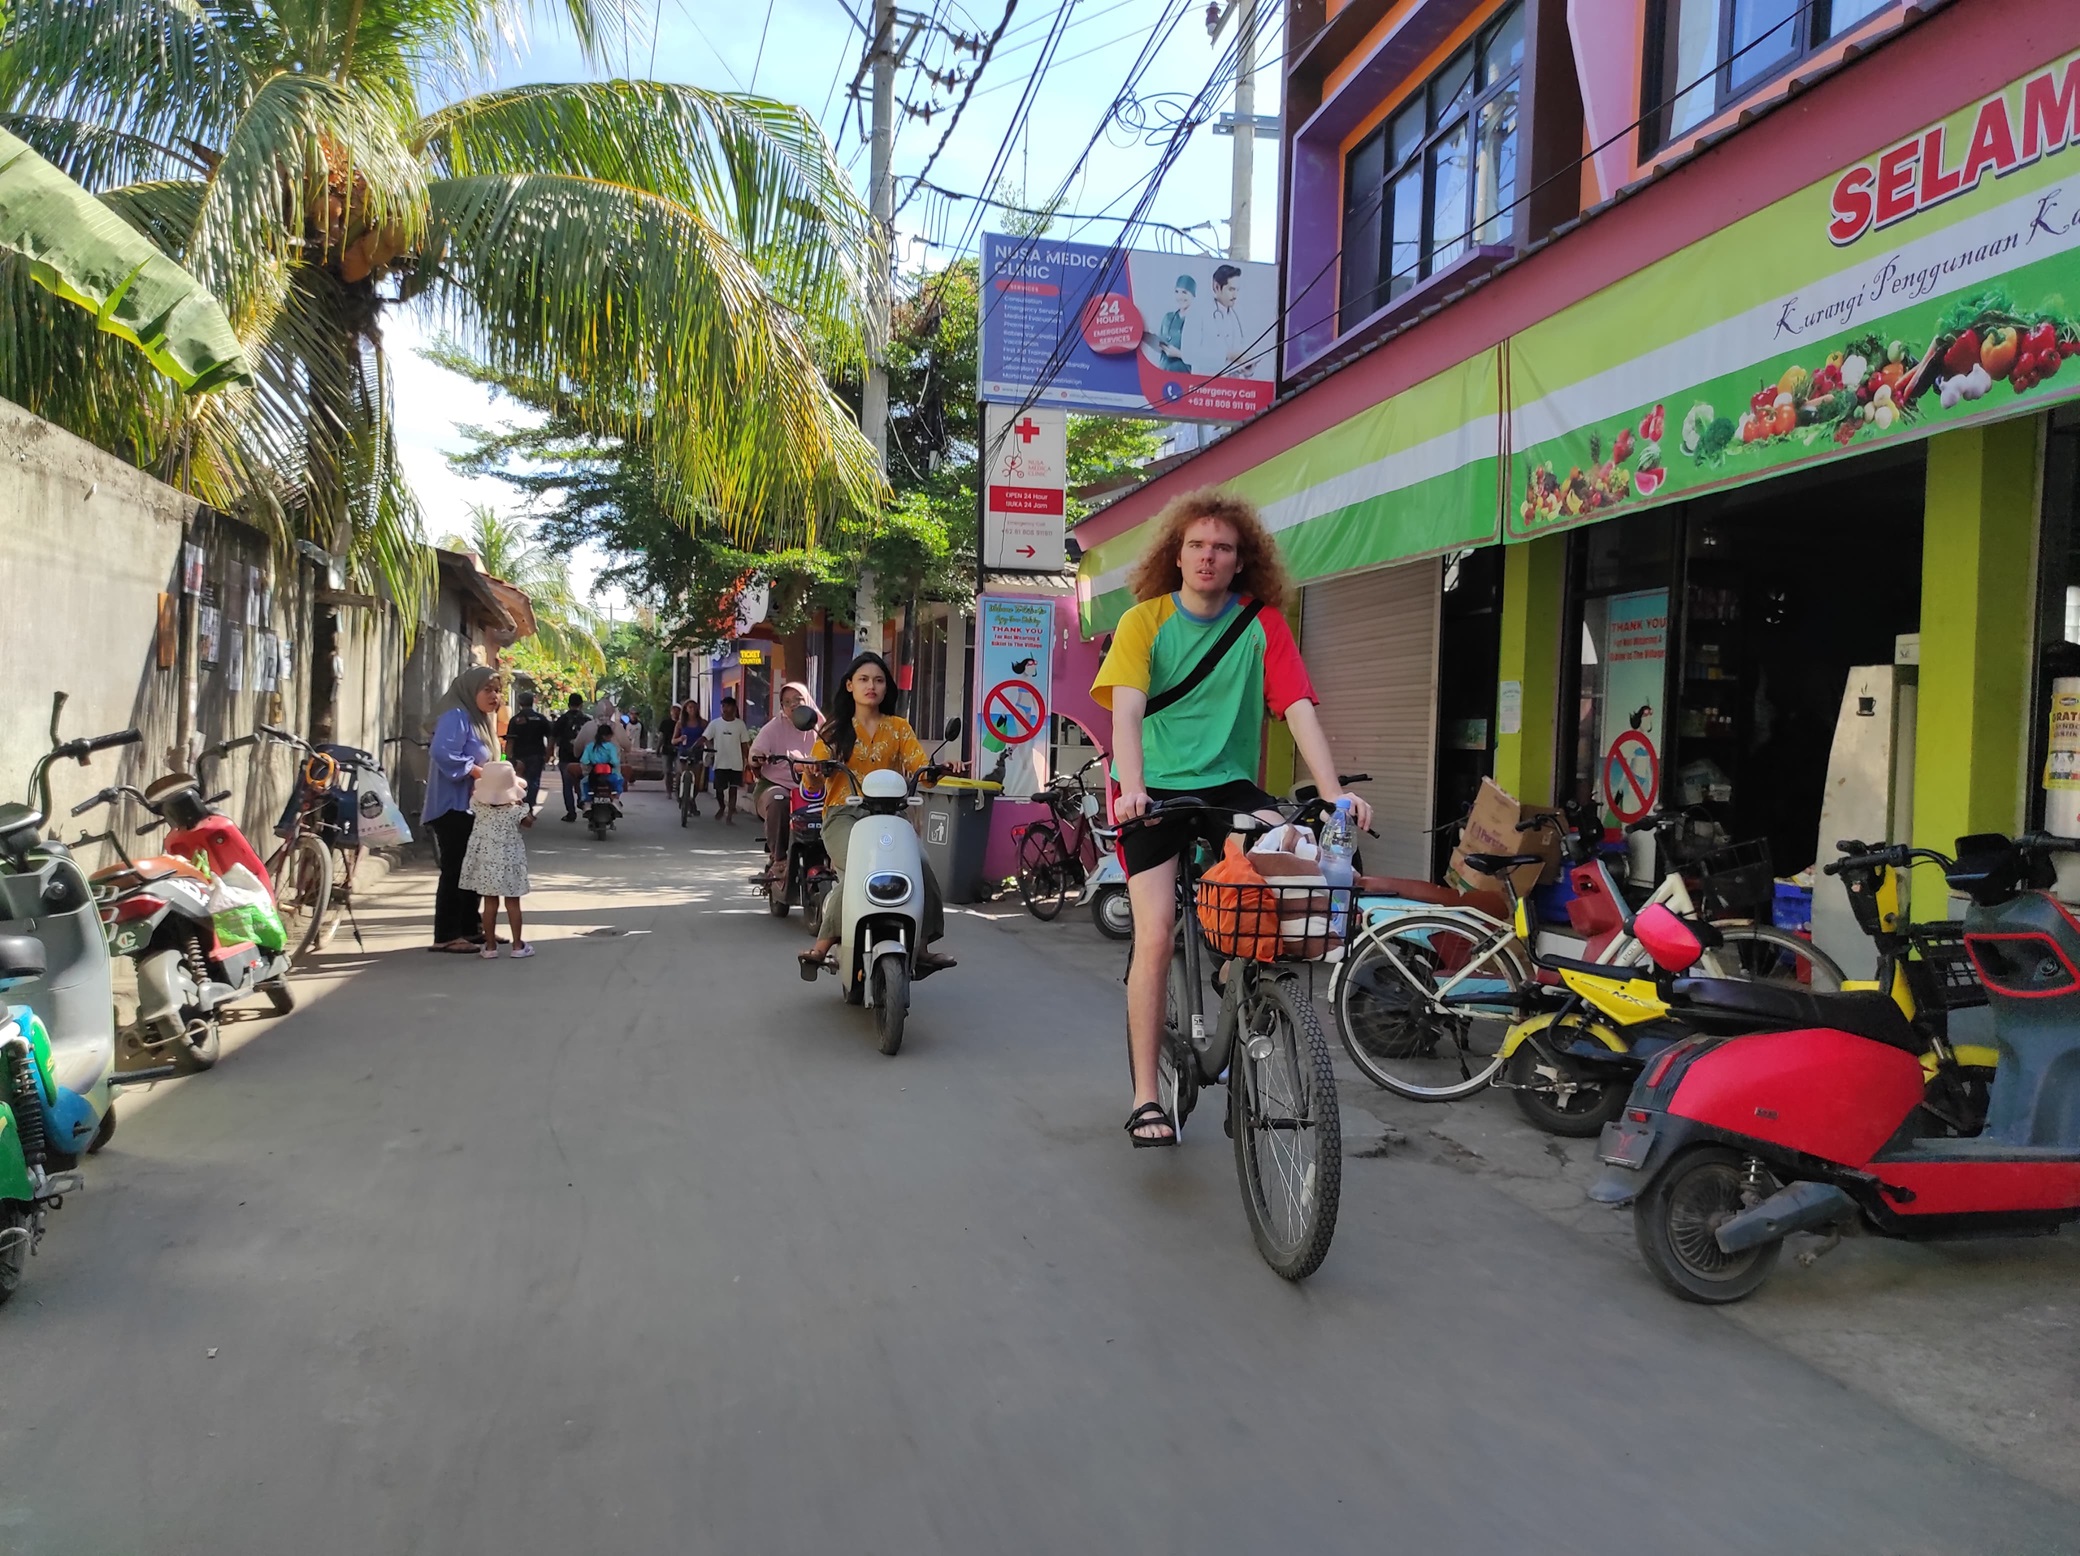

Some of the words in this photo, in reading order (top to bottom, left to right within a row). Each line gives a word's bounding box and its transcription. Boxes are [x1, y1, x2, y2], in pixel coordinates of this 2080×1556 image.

[1827, 55, 2080, 247] SELAM
[995, 245, 1041, 262] NUSA
[994, 261, 1050, 280] CLINIC
[1773, 284, 1866, 341] Kurangi
[1870, 232, 2019, 300] Penggunaan
[1100, 300, 1120, 316] 24
[1096, 314, 1125, 325] HOURS
[1093, 326, 1134, 338] EMERGENCY
[1100, 335, 1130, 344] SERVICES
[1238, 389, 1256, 398] Call
[1188, 397, 1204, 406] +62
[1232, 401, 1244, 410] 911
[1244, 402, 1256, 411] 911
[1612, 620, 1642, 632] THANK
[1646, 617, 1666, 628] YOU
[740, 650, 760, 658] TICKET
